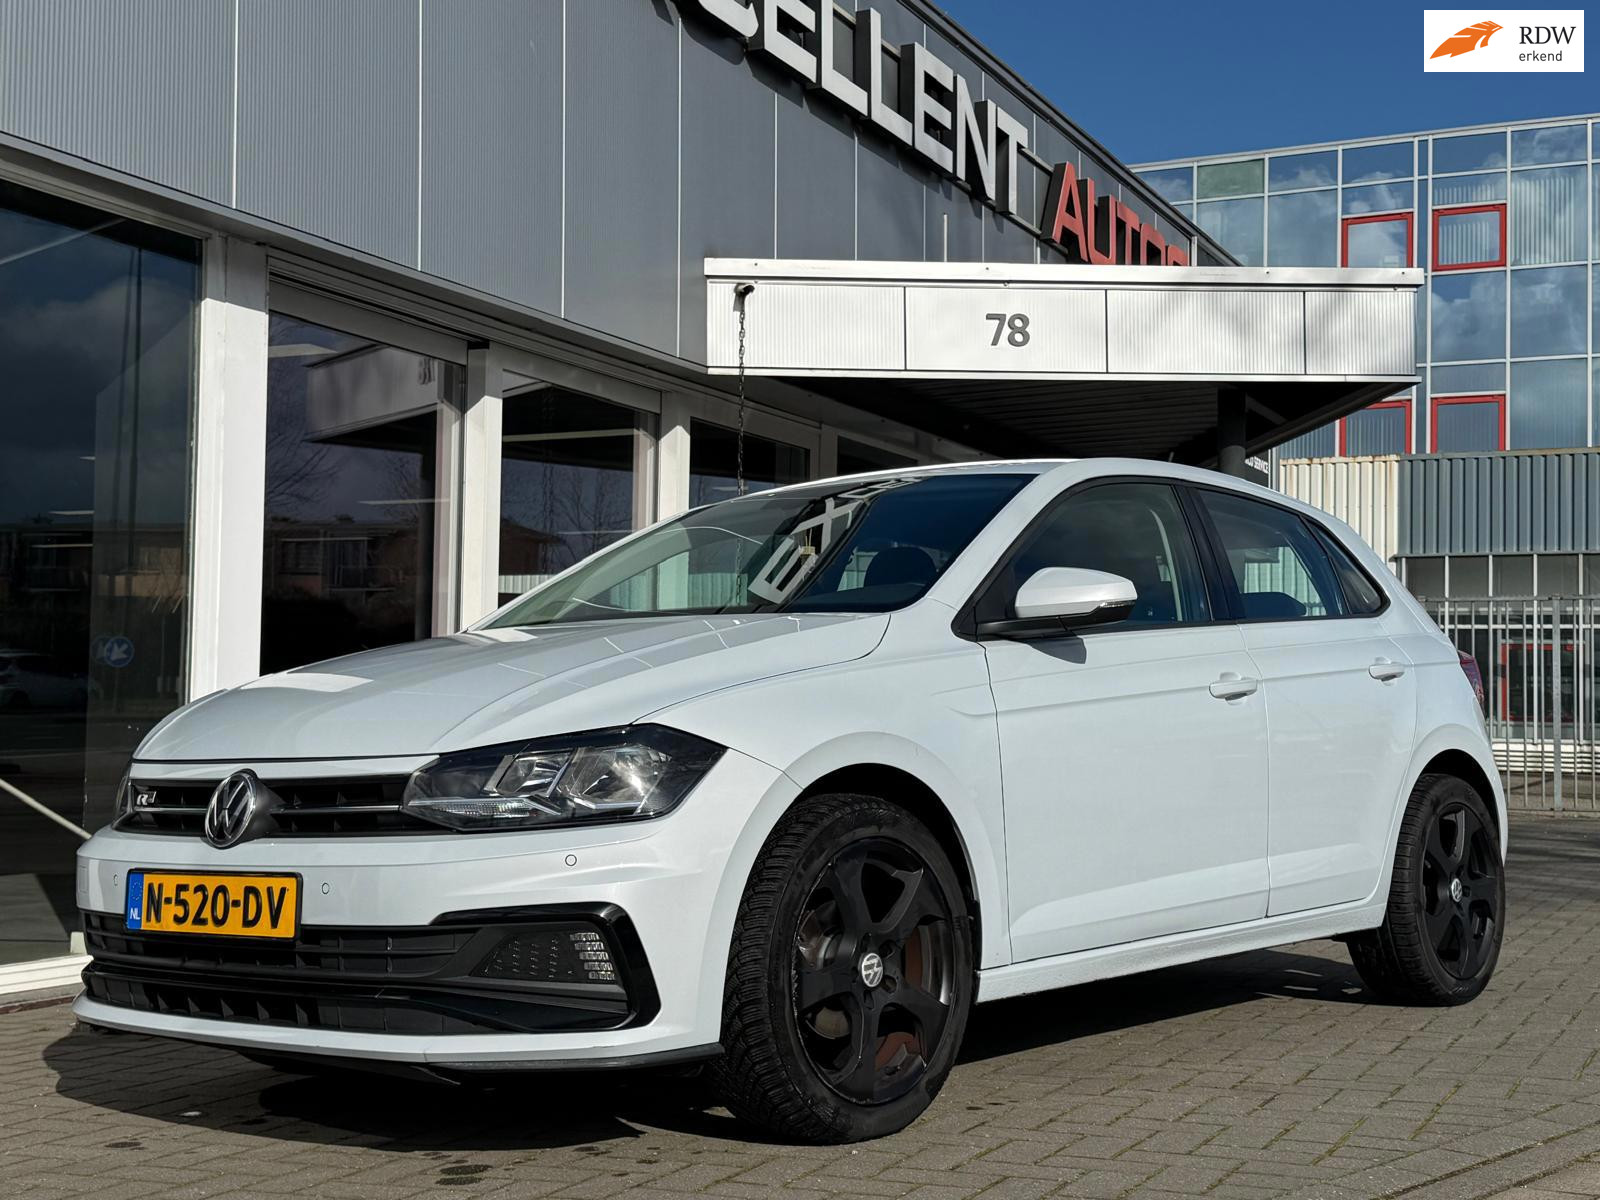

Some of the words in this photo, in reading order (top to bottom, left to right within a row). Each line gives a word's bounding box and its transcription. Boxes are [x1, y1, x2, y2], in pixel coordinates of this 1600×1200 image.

[985, 313, 1031, 347] 78
[129, 907, 141, 920] NL
[145, 882, 287, 930] N-520-DV
